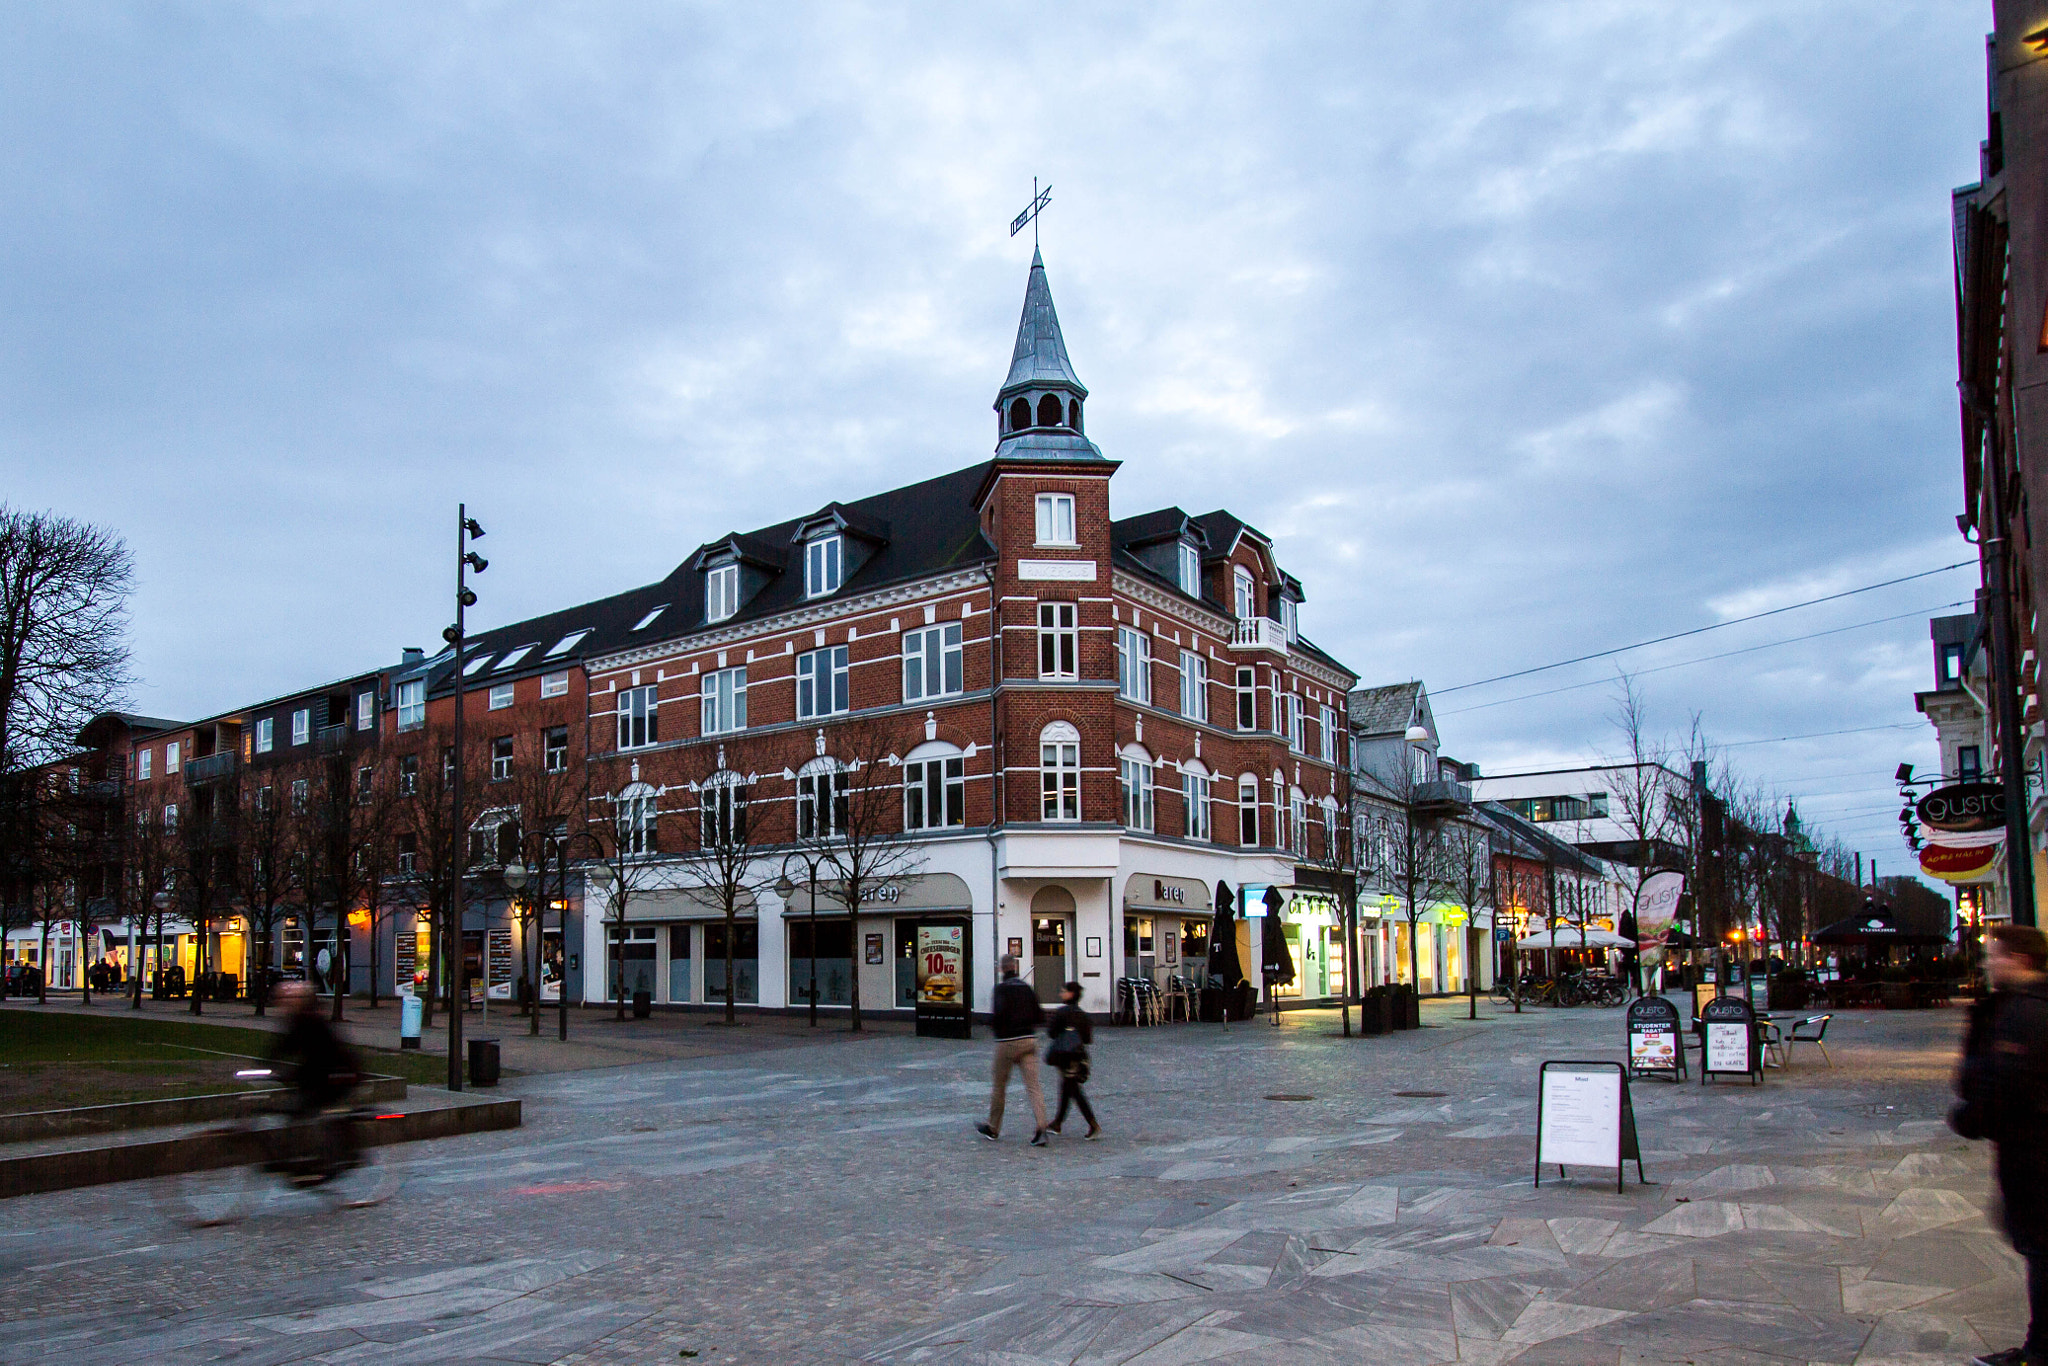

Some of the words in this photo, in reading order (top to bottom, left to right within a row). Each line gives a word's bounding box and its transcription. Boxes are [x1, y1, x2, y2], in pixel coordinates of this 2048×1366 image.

[1926, 849, 1985, 863] ADRENALIN
[852, 883, 900, 904] aren
[1154, 879, 1185, 903] Baren
[920, 945, 961, 955] CHEESEBURGER
[925, 953, 944, 975] 10
[944, 964, 957, 975] KR.
